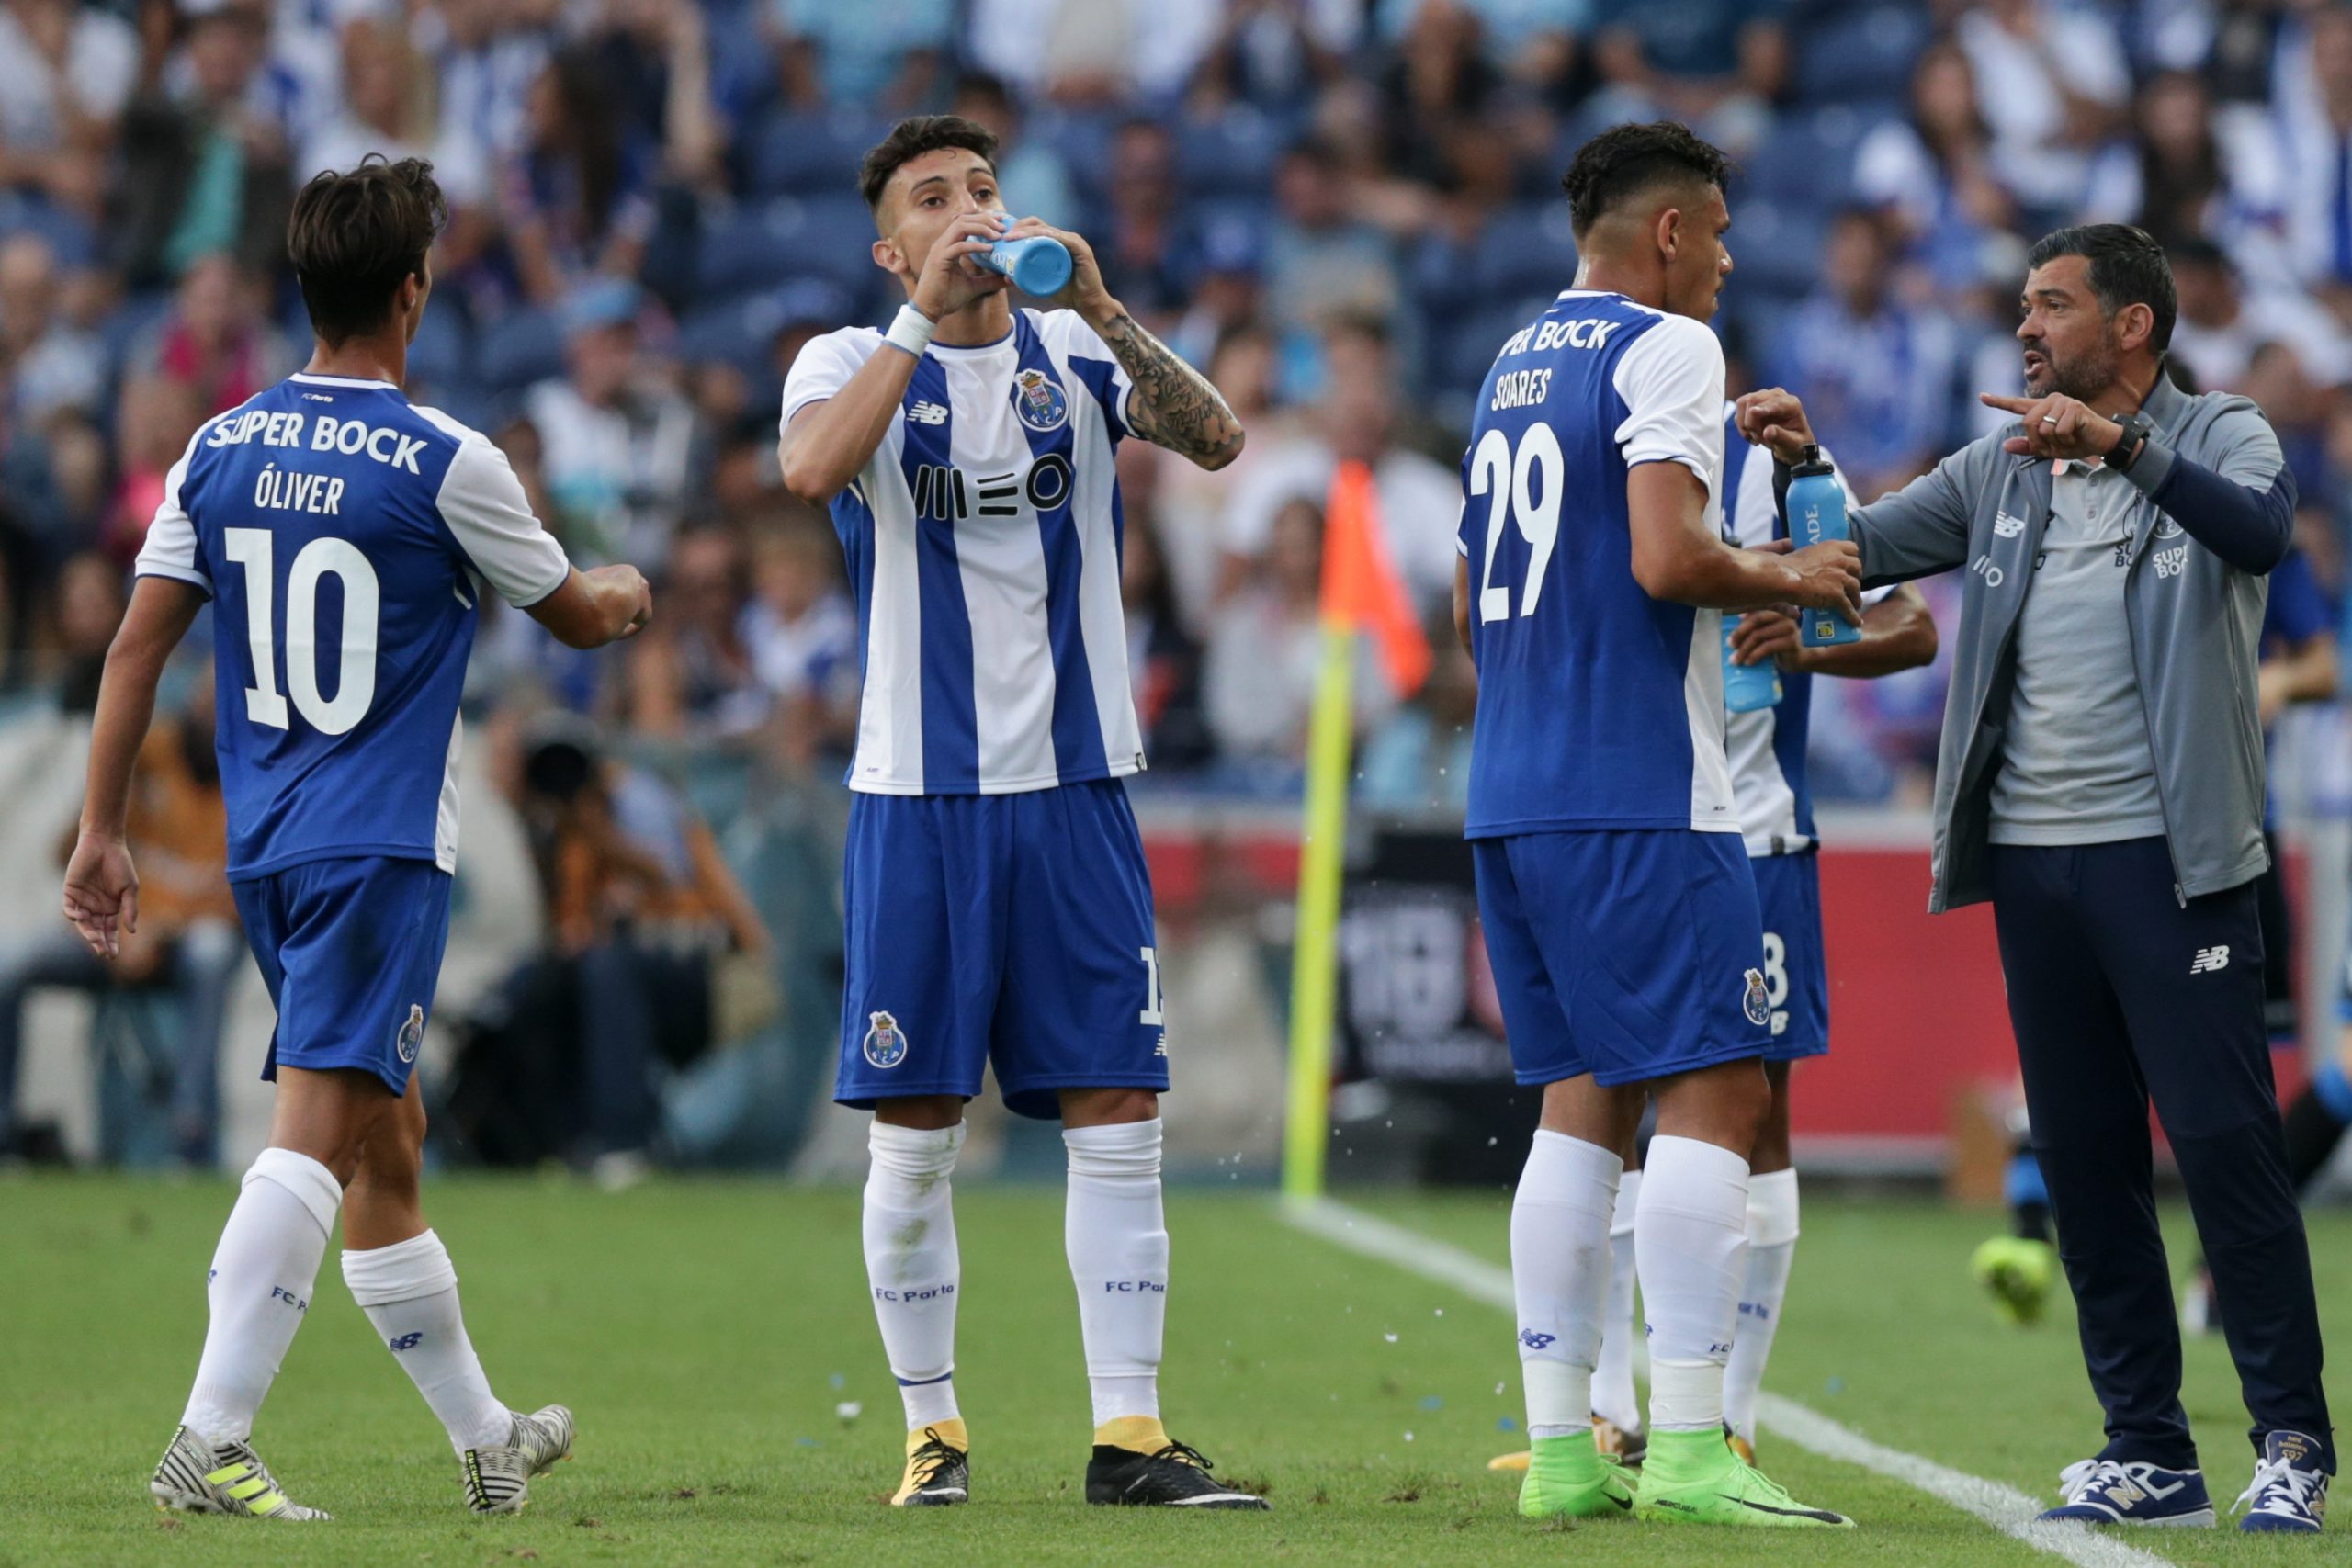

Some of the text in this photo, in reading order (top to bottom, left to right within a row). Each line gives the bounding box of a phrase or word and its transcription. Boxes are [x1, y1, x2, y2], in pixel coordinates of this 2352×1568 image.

[1533, 319, 1621, 351] BOCK
[1491, 368, 1553, 412] SOARES
[207, 410, 428, 476] SUPER BOCK
[254, 463, 345, 515] ÓLIVER
[1470, 422, 1565, 626] 29
[224, 526, 380, 736] 10
[876, 1285, 955, 1303] FC Porto
[1105, 1281, 1133, 1292] FC
